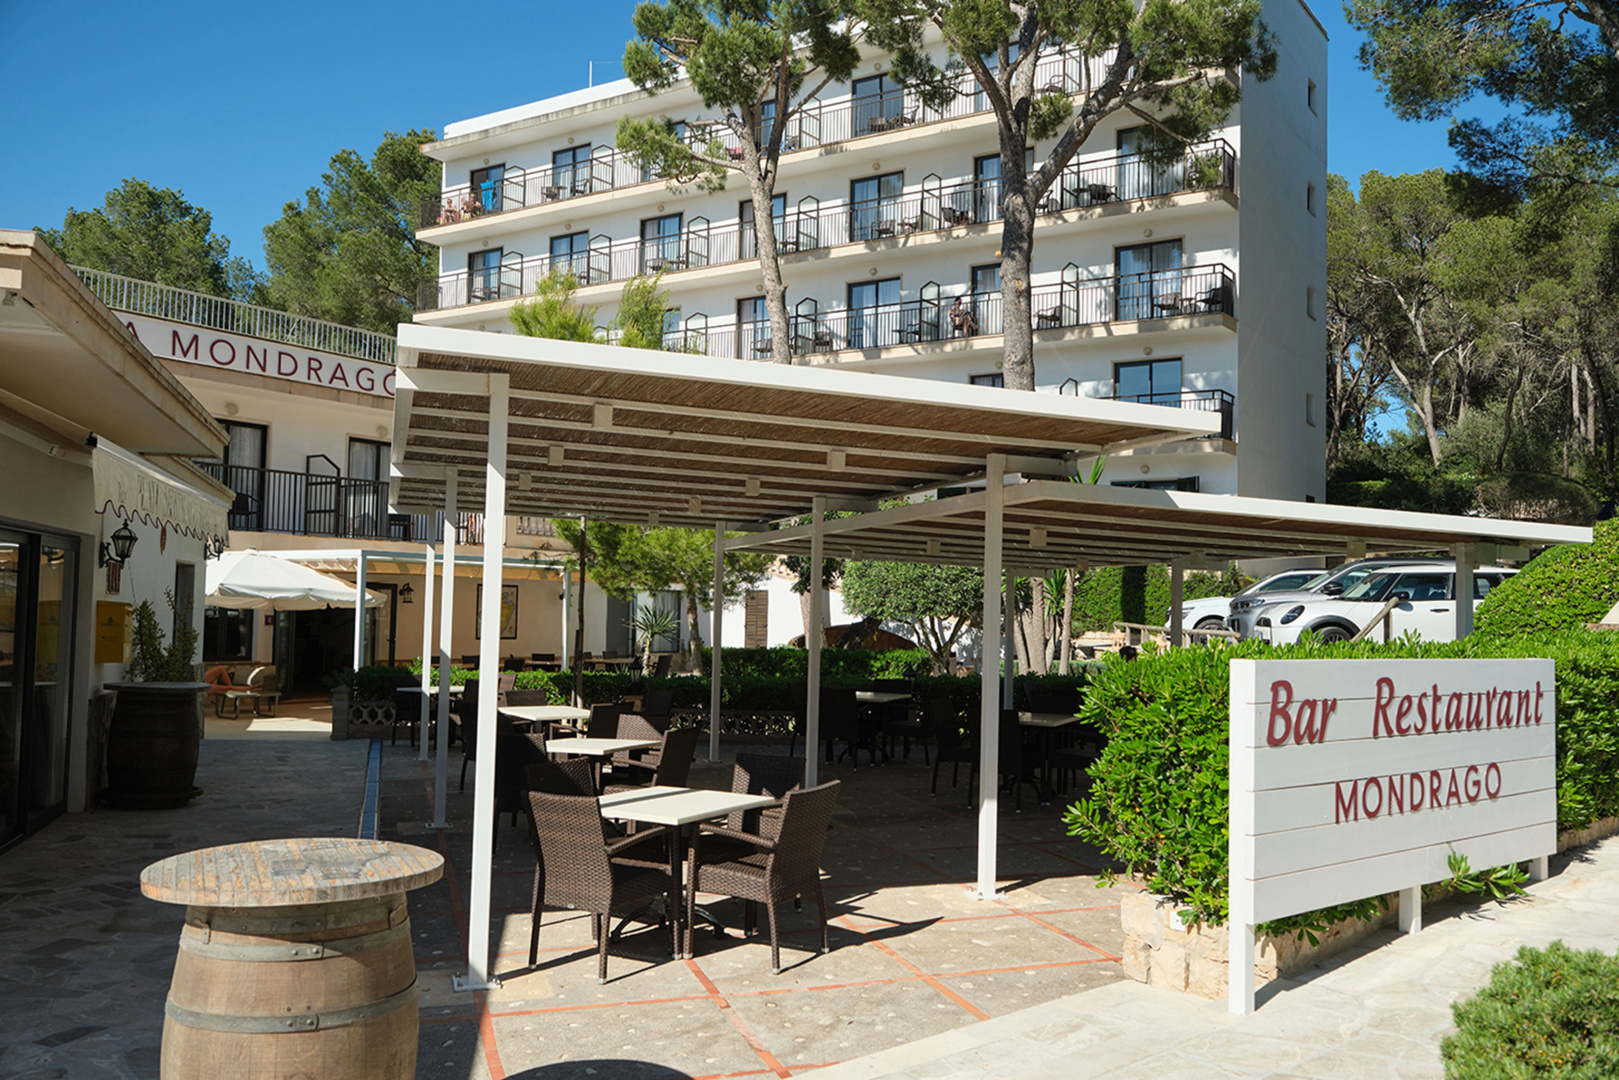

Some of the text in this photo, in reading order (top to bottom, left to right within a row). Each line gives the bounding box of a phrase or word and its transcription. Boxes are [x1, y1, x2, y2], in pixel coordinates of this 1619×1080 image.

[1267, 677, 1544, 747] Bar Restaurant
[1335, 762, 1502, 824] MONDRAGO
